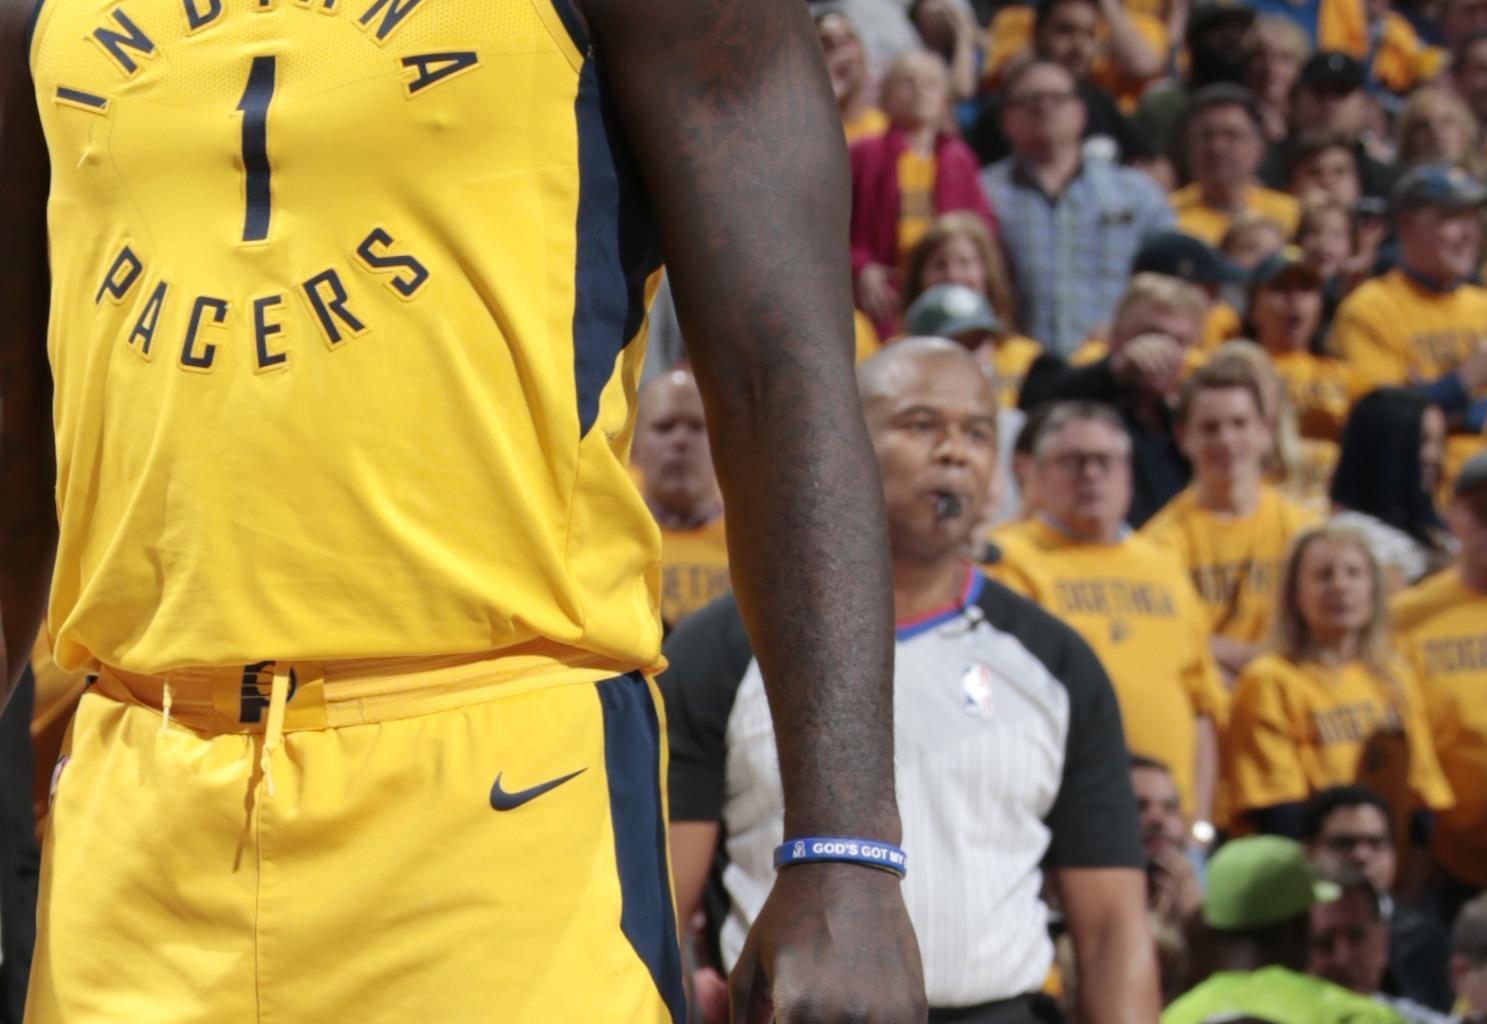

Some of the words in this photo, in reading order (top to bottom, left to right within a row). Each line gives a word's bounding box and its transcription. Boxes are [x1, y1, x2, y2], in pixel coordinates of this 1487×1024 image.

[234, 54, 277, 243] 1
[94, 227, 431, 371] PACERS
[812, 842, 858, 856] GOD'S
[861, 845, 888, 860] GOT
